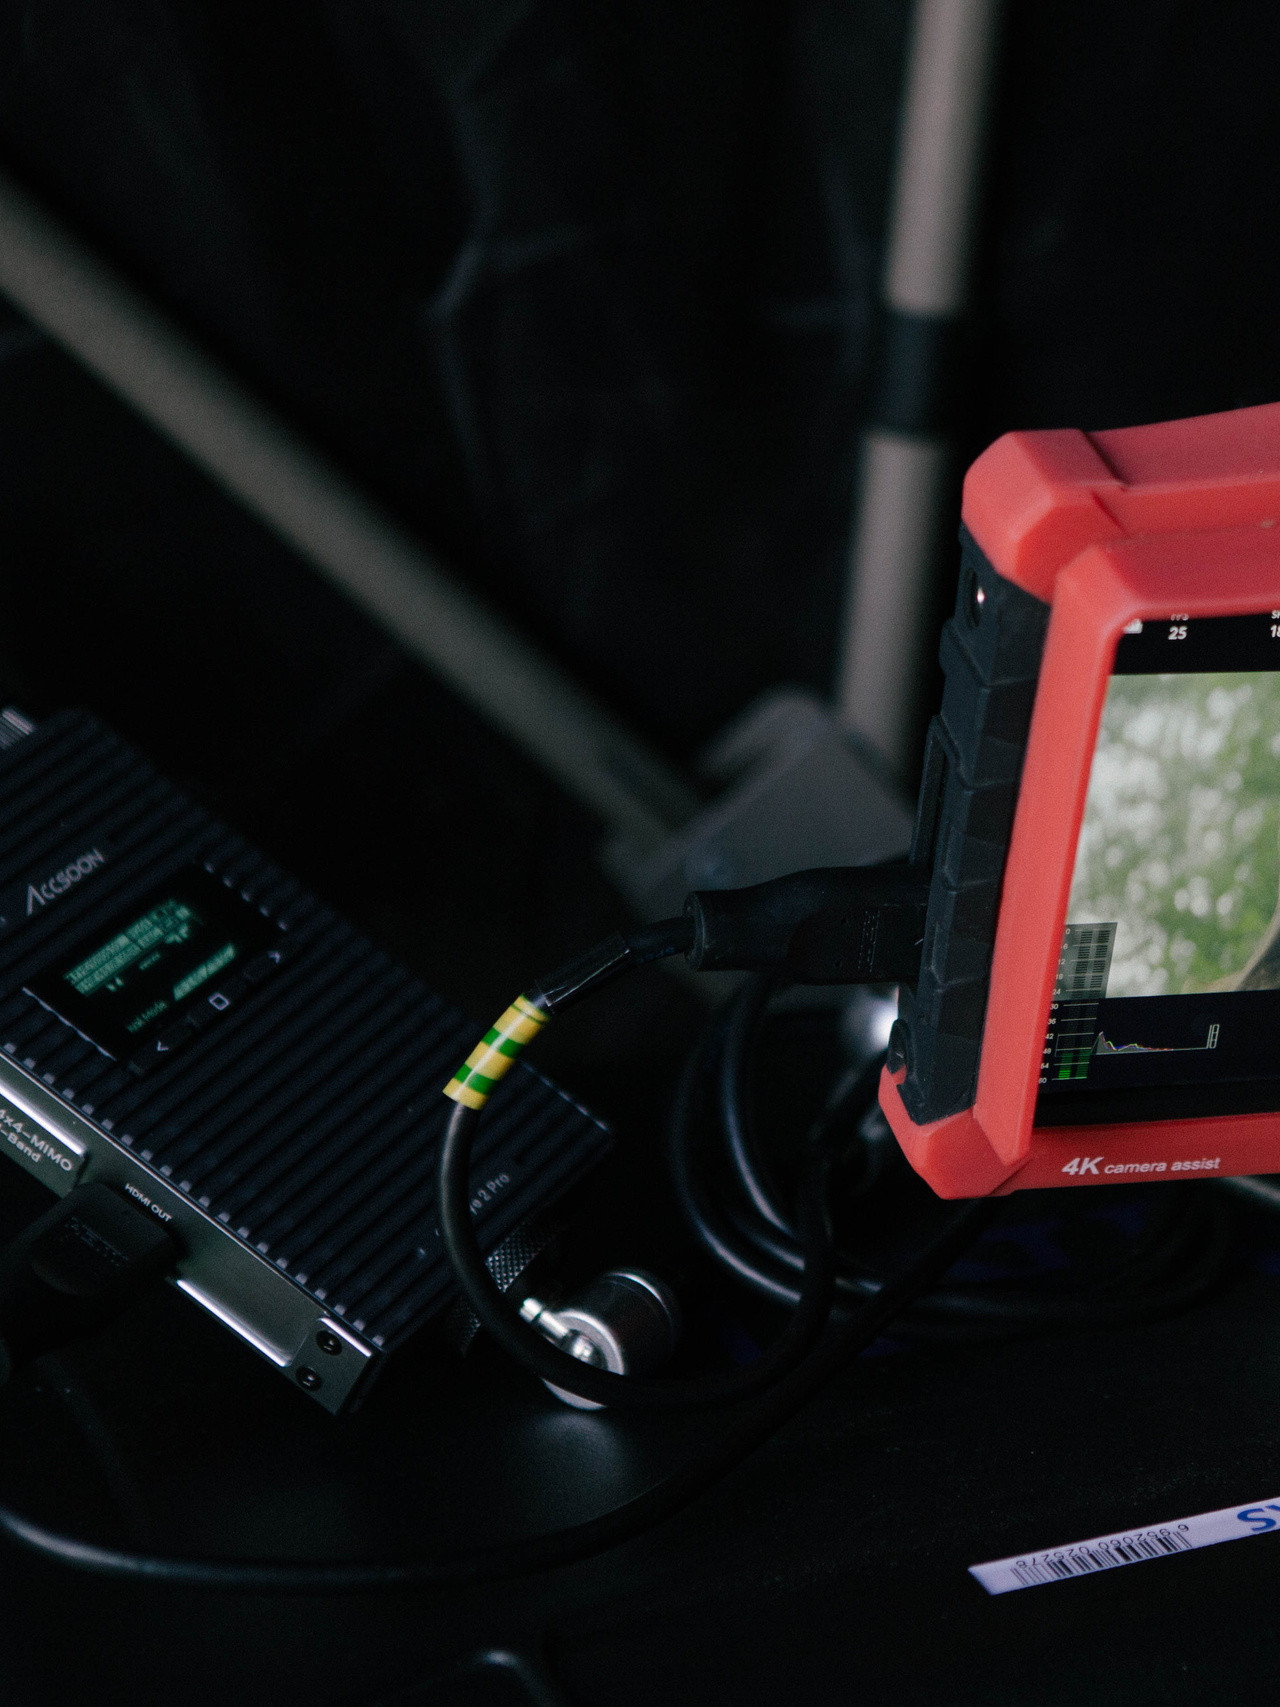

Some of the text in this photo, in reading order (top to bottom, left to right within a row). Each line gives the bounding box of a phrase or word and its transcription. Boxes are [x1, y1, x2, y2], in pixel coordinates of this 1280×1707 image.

[1167, 625, 1188, 641] 25
[1061, 1156, 1222, 1175] 4K camera assist
[478, 1173, 510, 1201] 2 Pro
[124, 1183, 173, 1223] HDMI OUT
